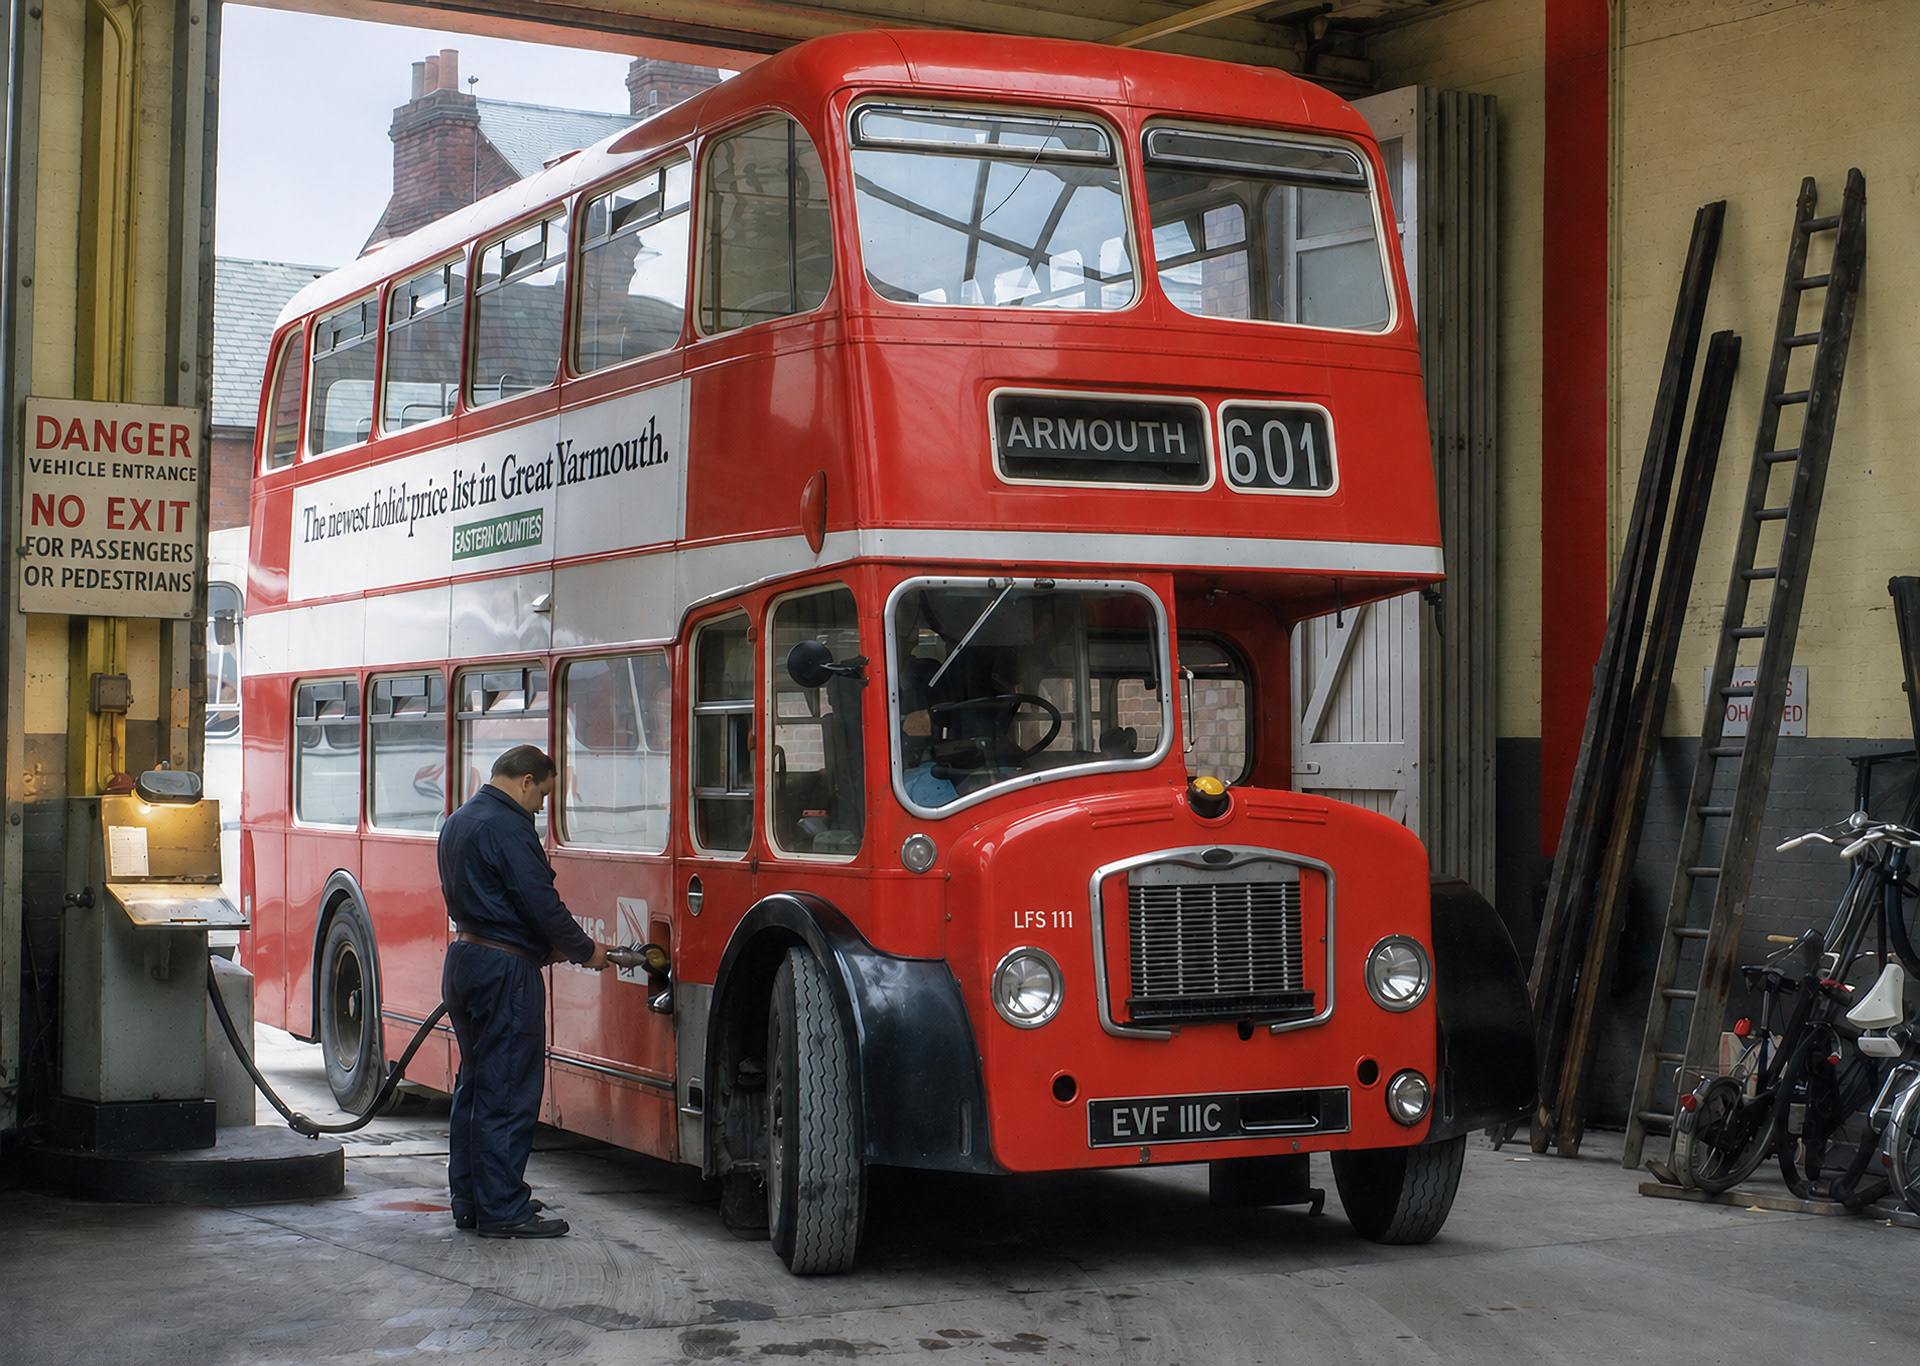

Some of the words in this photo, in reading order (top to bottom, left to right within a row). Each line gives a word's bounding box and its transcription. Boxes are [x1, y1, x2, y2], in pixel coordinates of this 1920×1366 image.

[36, 414, 192, 458] DANGER
[1006, 416, 1187, 455] ARMOUTH
[1225, 418, 1319, 487] 601
[29, 457, 106, 477] VEHICLE
[112, 463, 197, 482] ENTRANCE
[303, 505, 326, 543] The
[327, 509, 371, 538] newest
[450, 469, 476, 512] list
[478, 462, 497, 505] in
[500, 453, 554, 500] Great
[556, 415, 669, 487] Yarmouth.
[31, 493, 86, 528] NO
[106, 496, 191, 533] EXIT
[26, 536, 64, 558] FOR
[70, 537, 194, 563] PASSENGERS
[454, 524, 495, 554] EASTERN
[495, 514, 542, 546] COUNTIES
[23, 565, 54, 588] OR
[61, 567, 193, 592] PEDESTRIANS
[1014, 911, 1047, 929] LFS
[1051, 911, 1074, 929] 111
[1112, 1105, 1170, 1137] EVF
